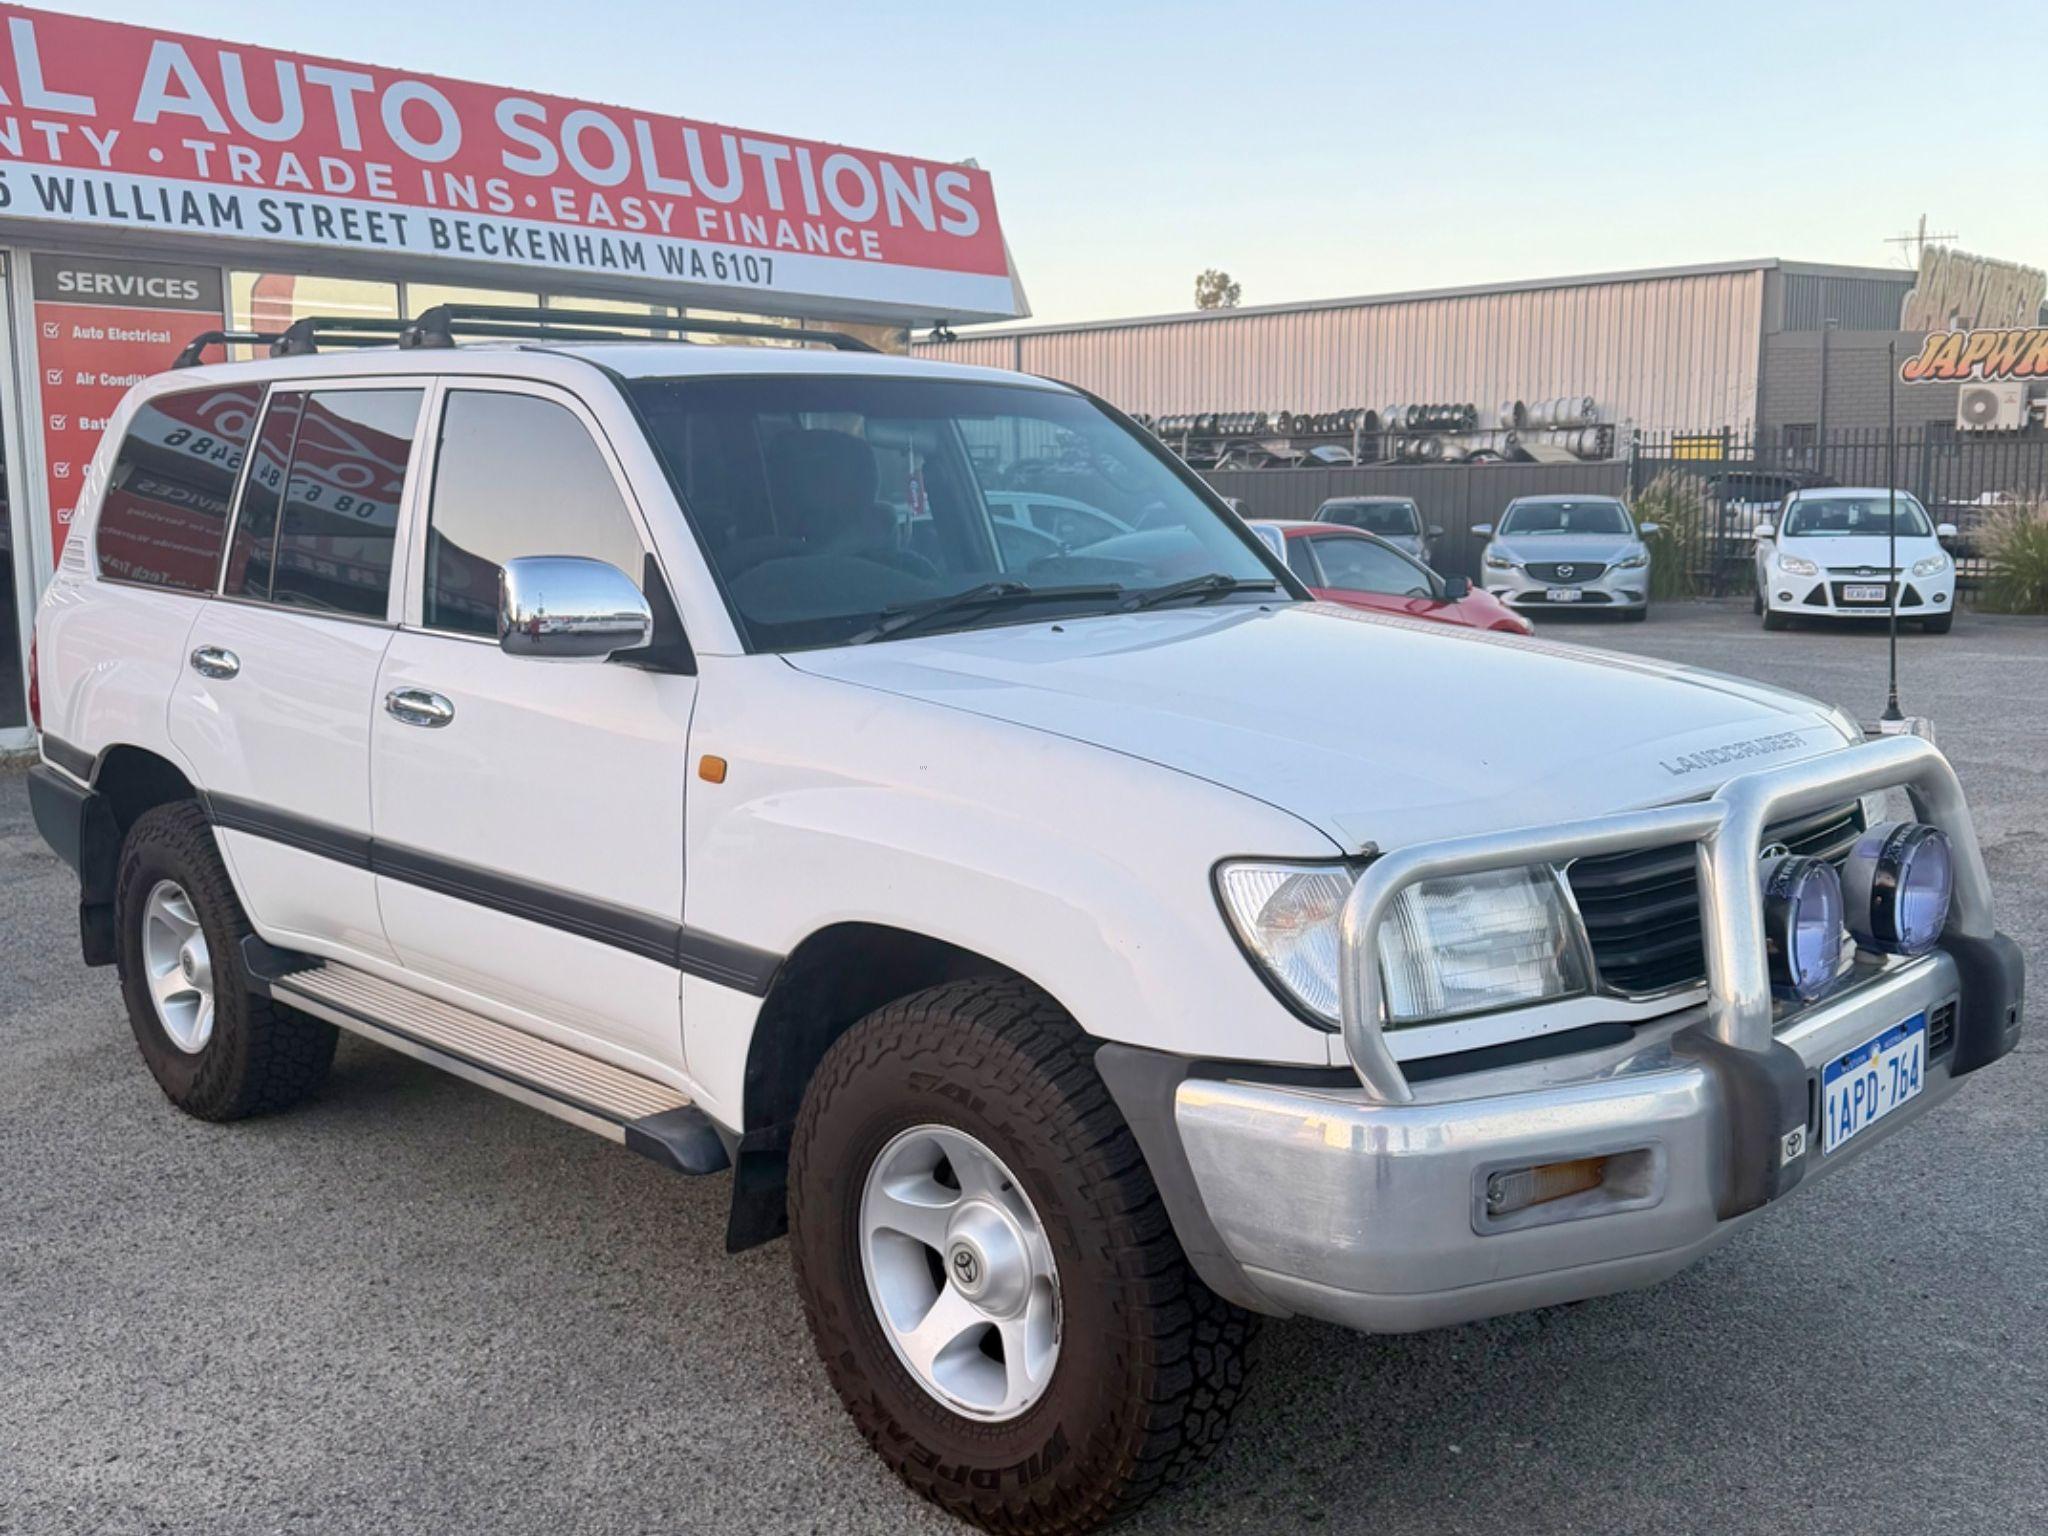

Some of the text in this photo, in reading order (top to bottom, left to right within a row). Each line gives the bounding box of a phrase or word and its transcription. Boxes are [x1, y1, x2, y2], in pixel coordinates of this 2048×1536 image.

[0, 17, 980, 237] L AUTO SOLUTIONS
[182, 138, 397, 200] TRADE
[422, 169, 515, 213] INS
[551, 186, 674, 233] EASY
[696, 206, 883, 260] FINANCE
[31, 172, 243, 230] WILLIAM
[258, 198, 407, 246] STREET
[429, 217, 646, 271] BECKENHAM
[712, 251, 773, 285] 6107
[57, 271, 200, 300] SERVICES
[73, 325, 171, 344] Auto Electrical
[76, 371, 96, 385] Air
[1658, 731, 1808, 776] LANDCRUISER
